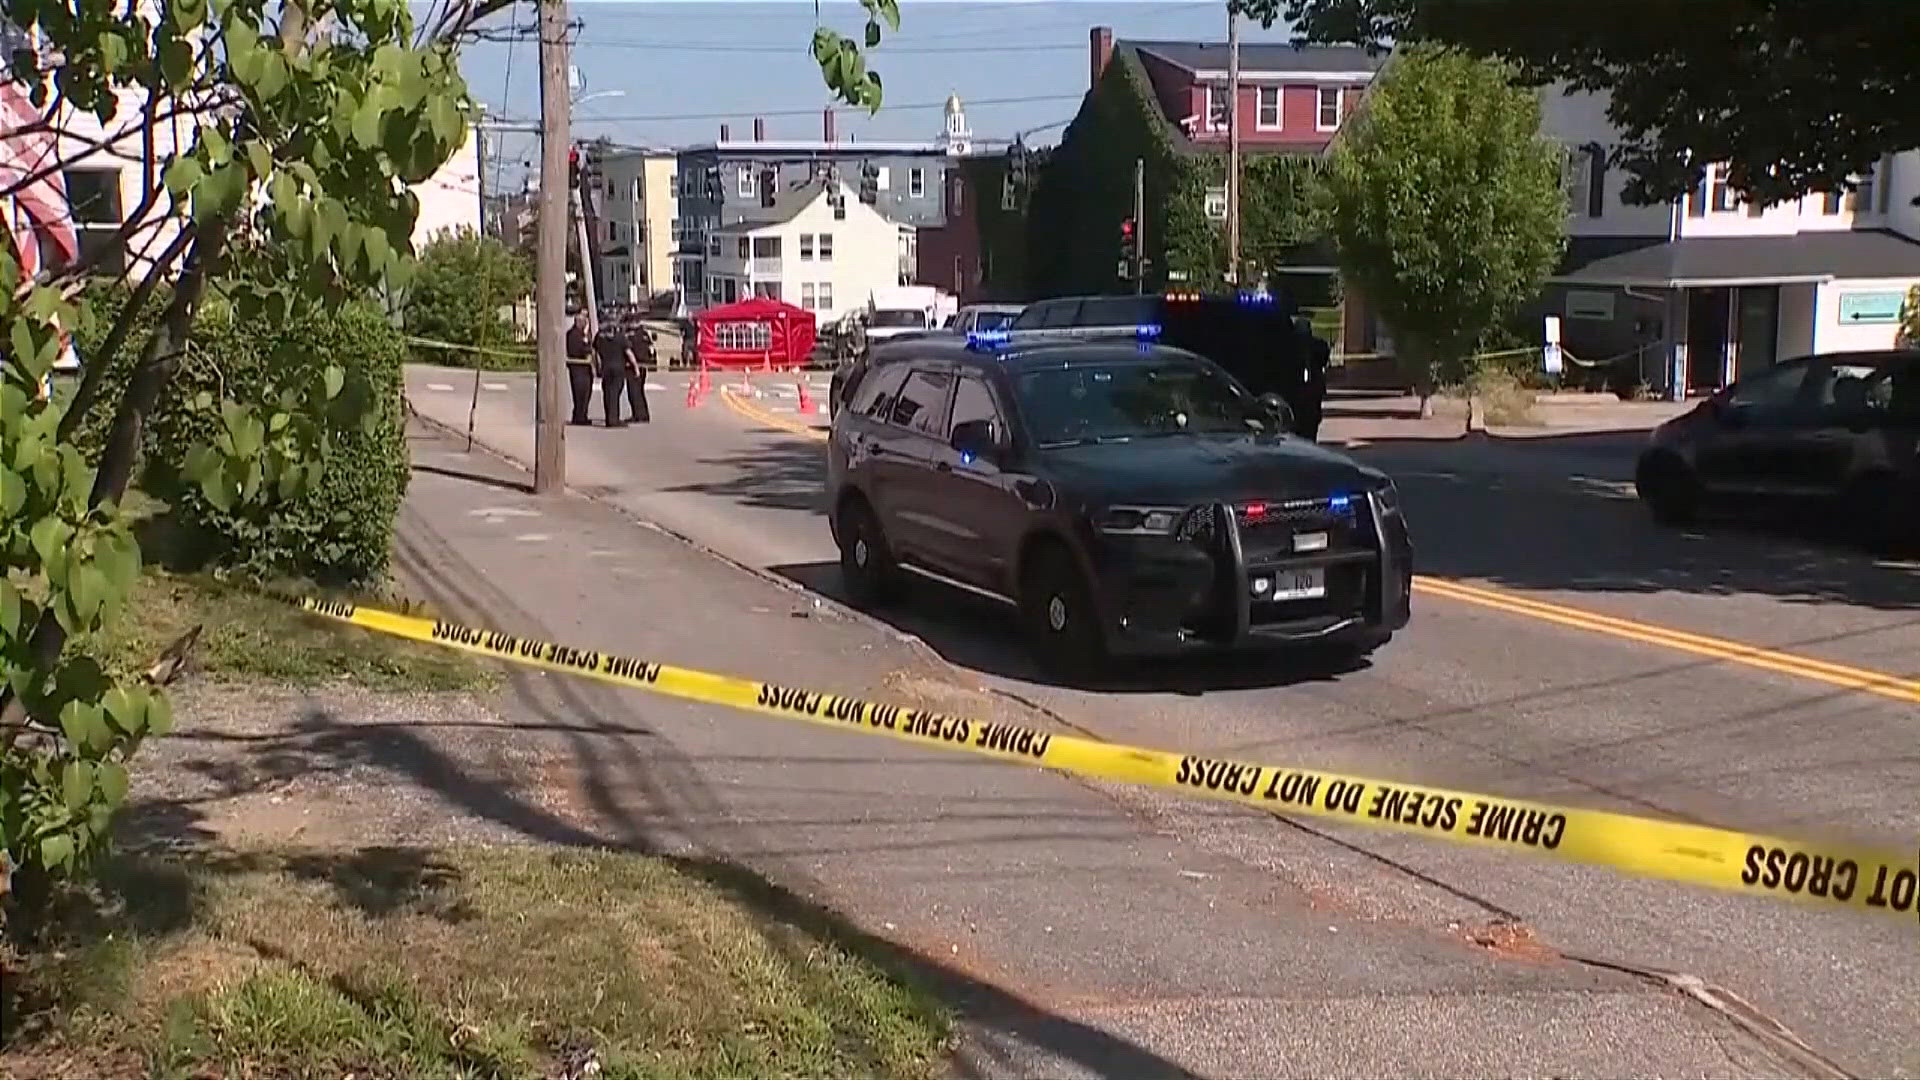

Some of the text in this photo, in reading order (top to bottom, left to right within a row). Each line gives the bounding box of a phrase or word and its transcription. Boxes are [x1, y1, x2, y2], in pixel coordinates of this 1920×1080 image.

[432, 618, 661, 682] CRIME SCENE DO NOT CROSS
[757, 683, 1049, 757] CRIME SCENE DO NOT CROSS
[1176, 756, 1566, 850] CRIME SCENE DO NOT CROSS
[1741, 844, 1858, 902] CROSS
